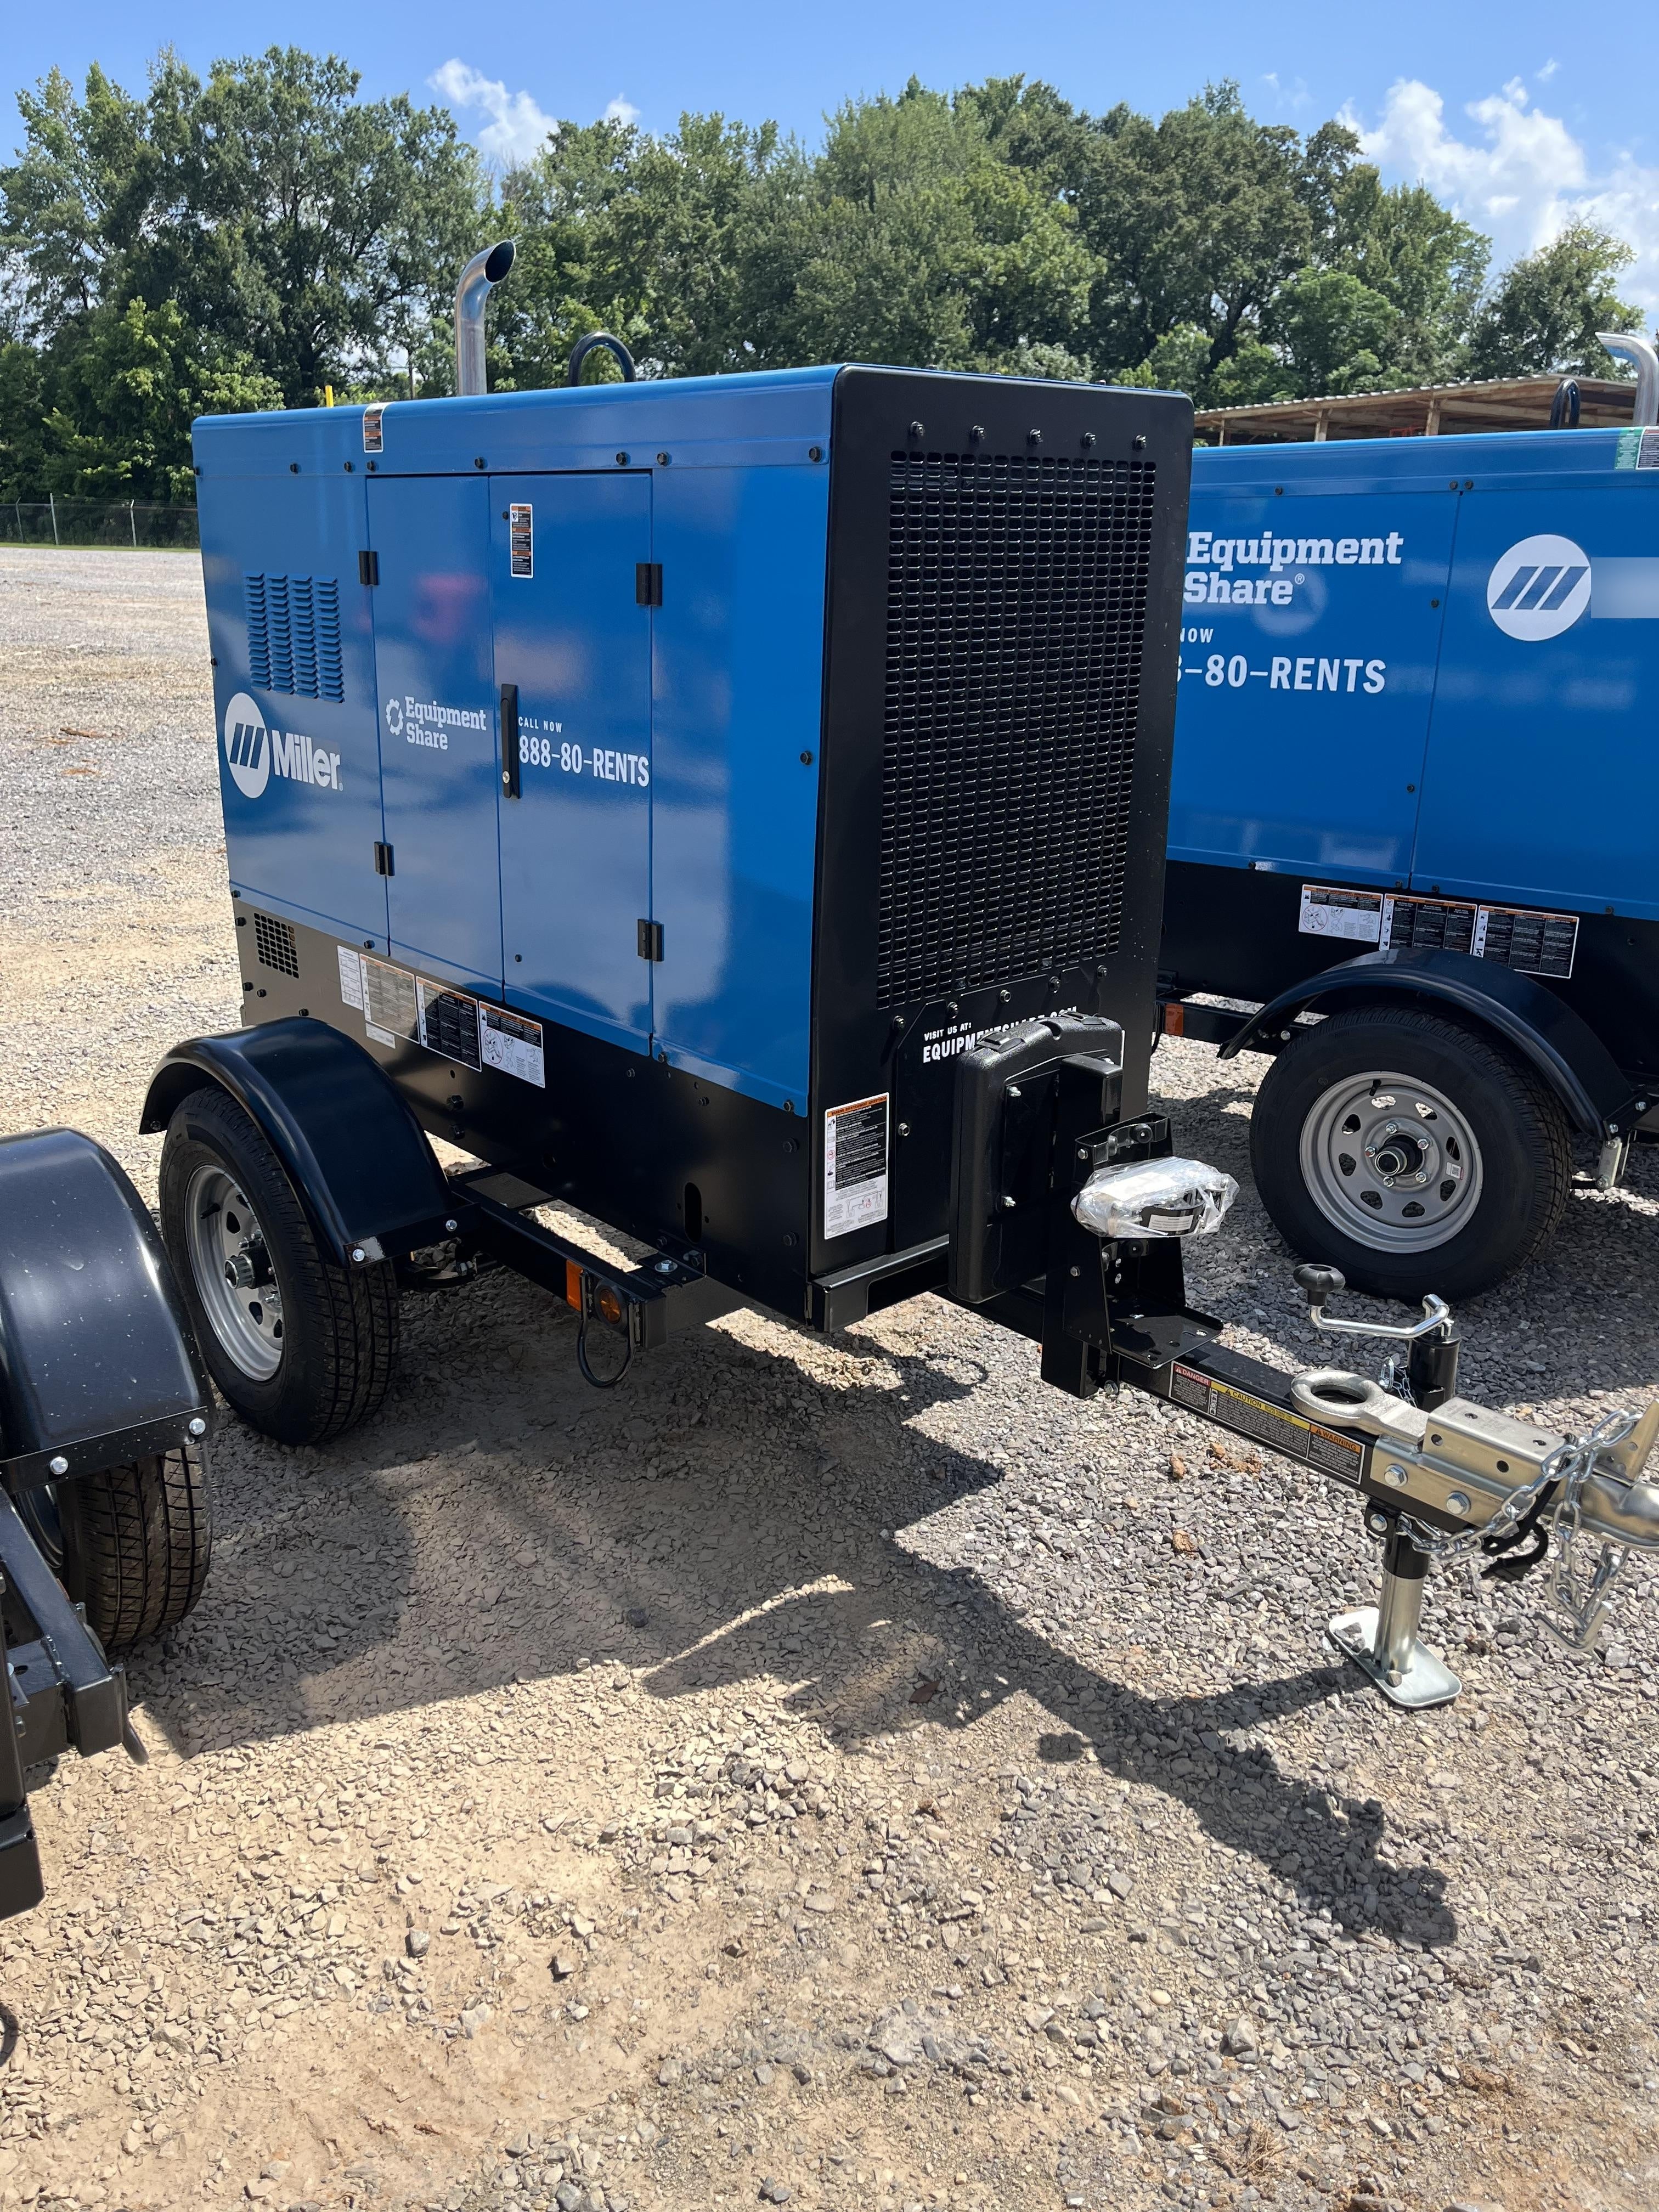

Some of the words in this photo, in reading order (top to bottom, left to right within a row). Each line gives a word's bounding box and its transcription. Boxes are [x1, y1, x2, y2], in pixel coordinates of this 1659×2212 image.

[1186, 531, 1404, 572] Equipment
[1177, 654, 1386, 693] -80-RENTS
[405, 696, 487, 731] Equipment
[518, 716, 539, 729] CALL
[544, 720, 562, 733] NOW
[406, 721, 448, 750] Share
[519, 735, 650, 787] 888-80-RENTS
[924, 1029, 944, 1041] VISIT
[947, 1025, 957, 1035] US
[960, 1022, 972, 1032] AT:
[1182, 1369, 1209, 1386] DANGER
[1232, 1391, 1262, 1408] CAUTION
[1323, 1430, 1356, 1450] WARNING
